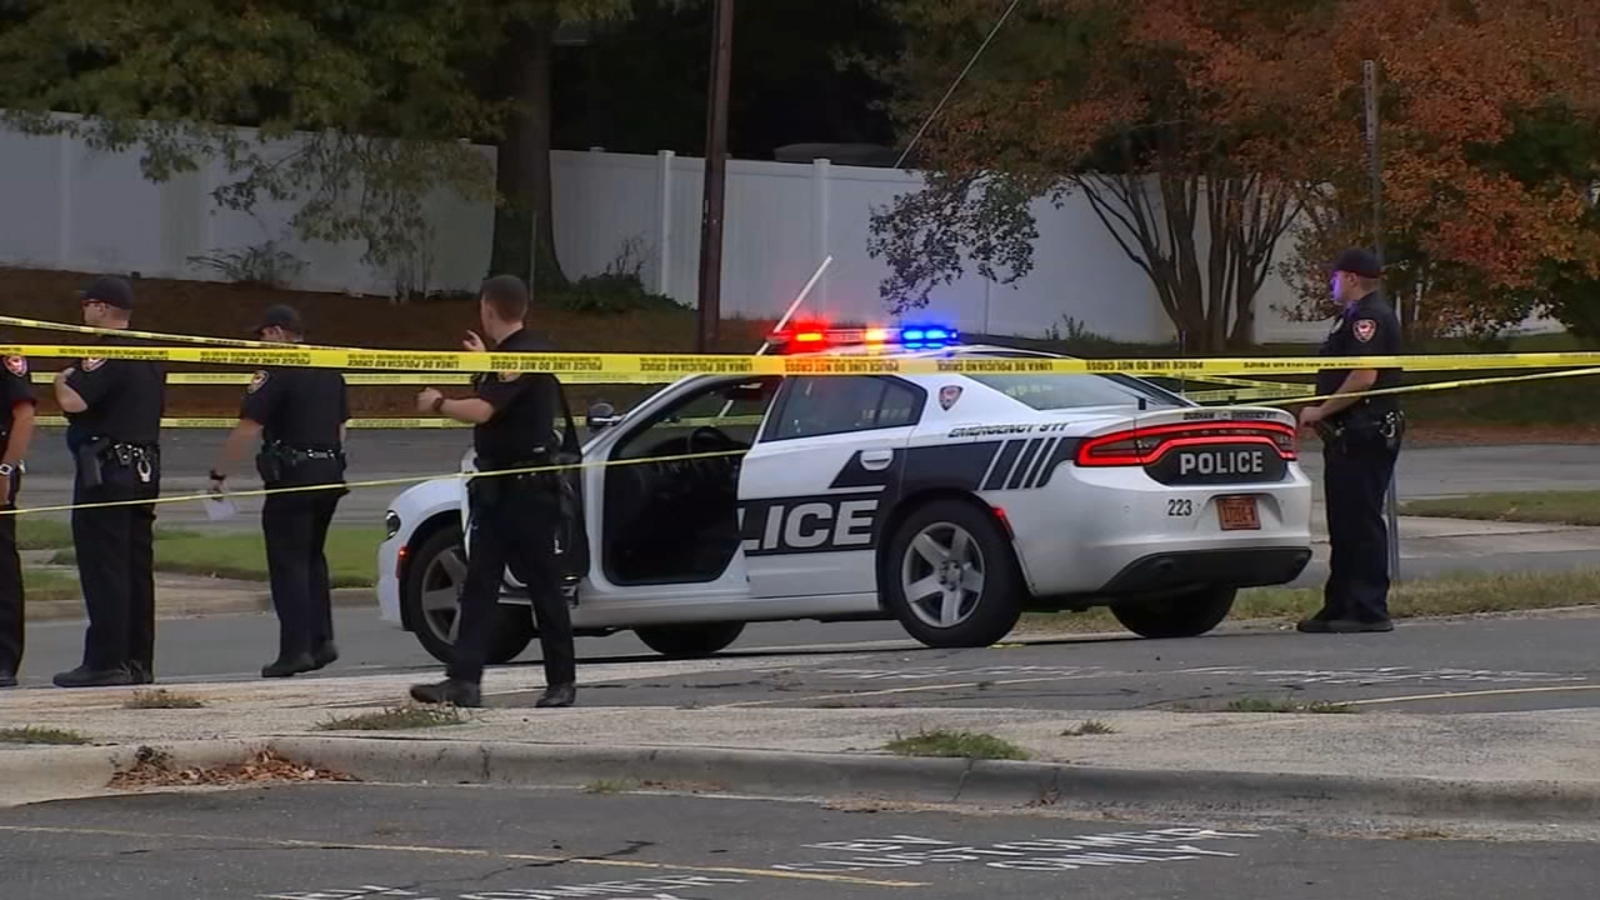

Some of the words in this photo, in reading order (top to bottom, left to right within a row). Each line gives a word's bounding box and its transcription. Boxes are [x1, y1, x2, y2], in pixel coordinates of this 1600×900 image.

[388, 359, 420, 369] POLICIA
[422, 360, 433, 369] DE
[435, 360, 460, 370] LINEA
[490, 361, 518, 370] CROSS
[519, 361, 536, 370] NOT
[538, 361, 551, 371] DO
[553, 361, 571, 371] LINE
[573, 361, 602, 371] POLICE
[640, 362, 667, 372] CRUCE
[681, 363, 713, 373] POLICIA
[715, 363, 726, 373] DE
[728, 363, 753, 373] LINEA
[785, 363, 813, 373] CROSS
[815, 363, 831, 373] NOT
[834, 363, 846, 373] DO
[848, 363, 867, 373] LINE
[869, 363, 899, 373] POLICE
[937, 363, 964, 372] CRUCE
[979, 362, 1013, 372] POLICIA
[1014, 362, 1026, 372] DE
[1028, 362, 1053, 372] LINEA
[1085, 361, 1116, 371] CROSS
[1116, 361, 1134, 371] NOT
[1136, 361, 1149, 370] DO
[1152, 361, 1171, 370] LINE
[1173, 361, 1204, 370] POLICE
[1179, 451, 1264, 475] POLICE
[1167, 499, 1192, 516] 223
[986, 844, 1240, 871] ONLY
